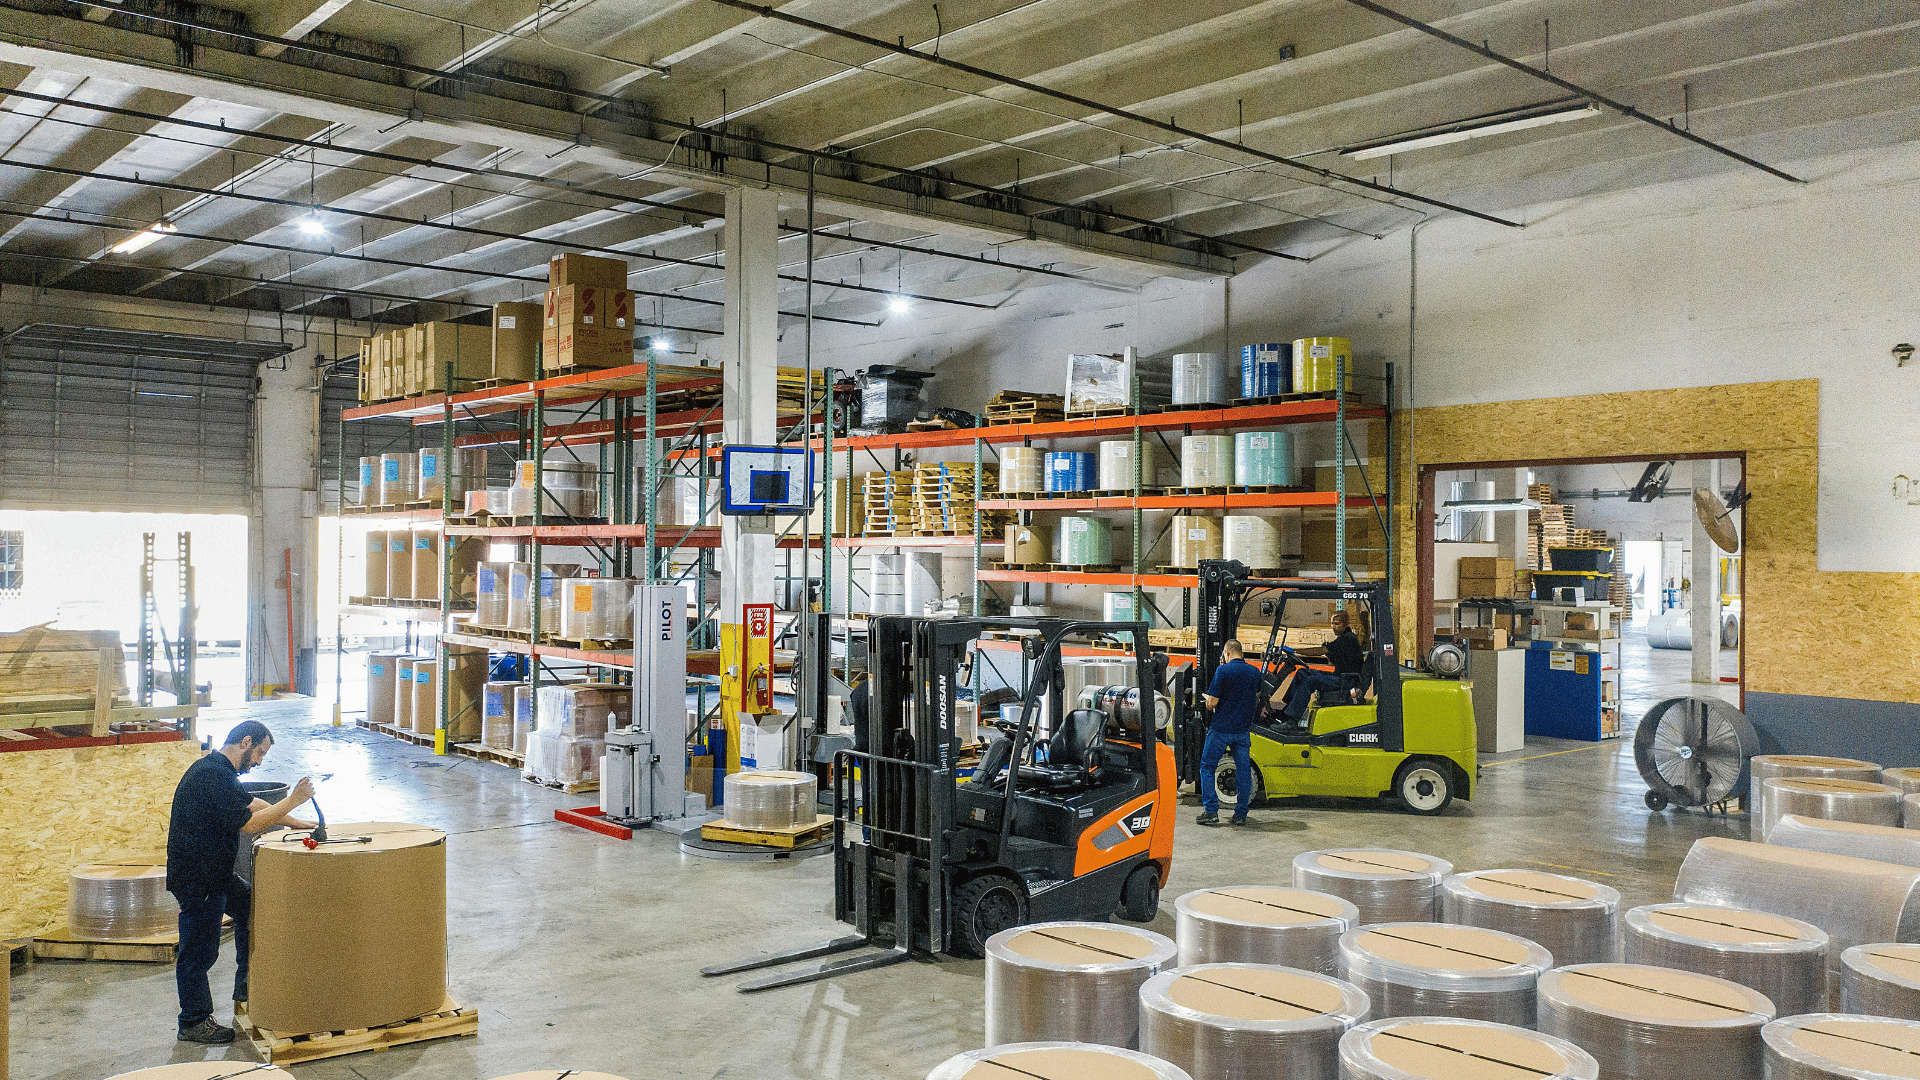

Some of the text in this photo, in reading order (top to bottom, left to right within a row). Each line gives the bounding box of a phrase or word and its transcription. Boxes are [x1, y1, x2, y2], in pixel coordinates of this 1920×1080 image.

[661, 600, 671, 641] PILOT
[1208, 605, 1218, 634] CLARK
[939, 674, 947, 730] DOOSAN
[1349, 733, 1379, 743] CLARK
